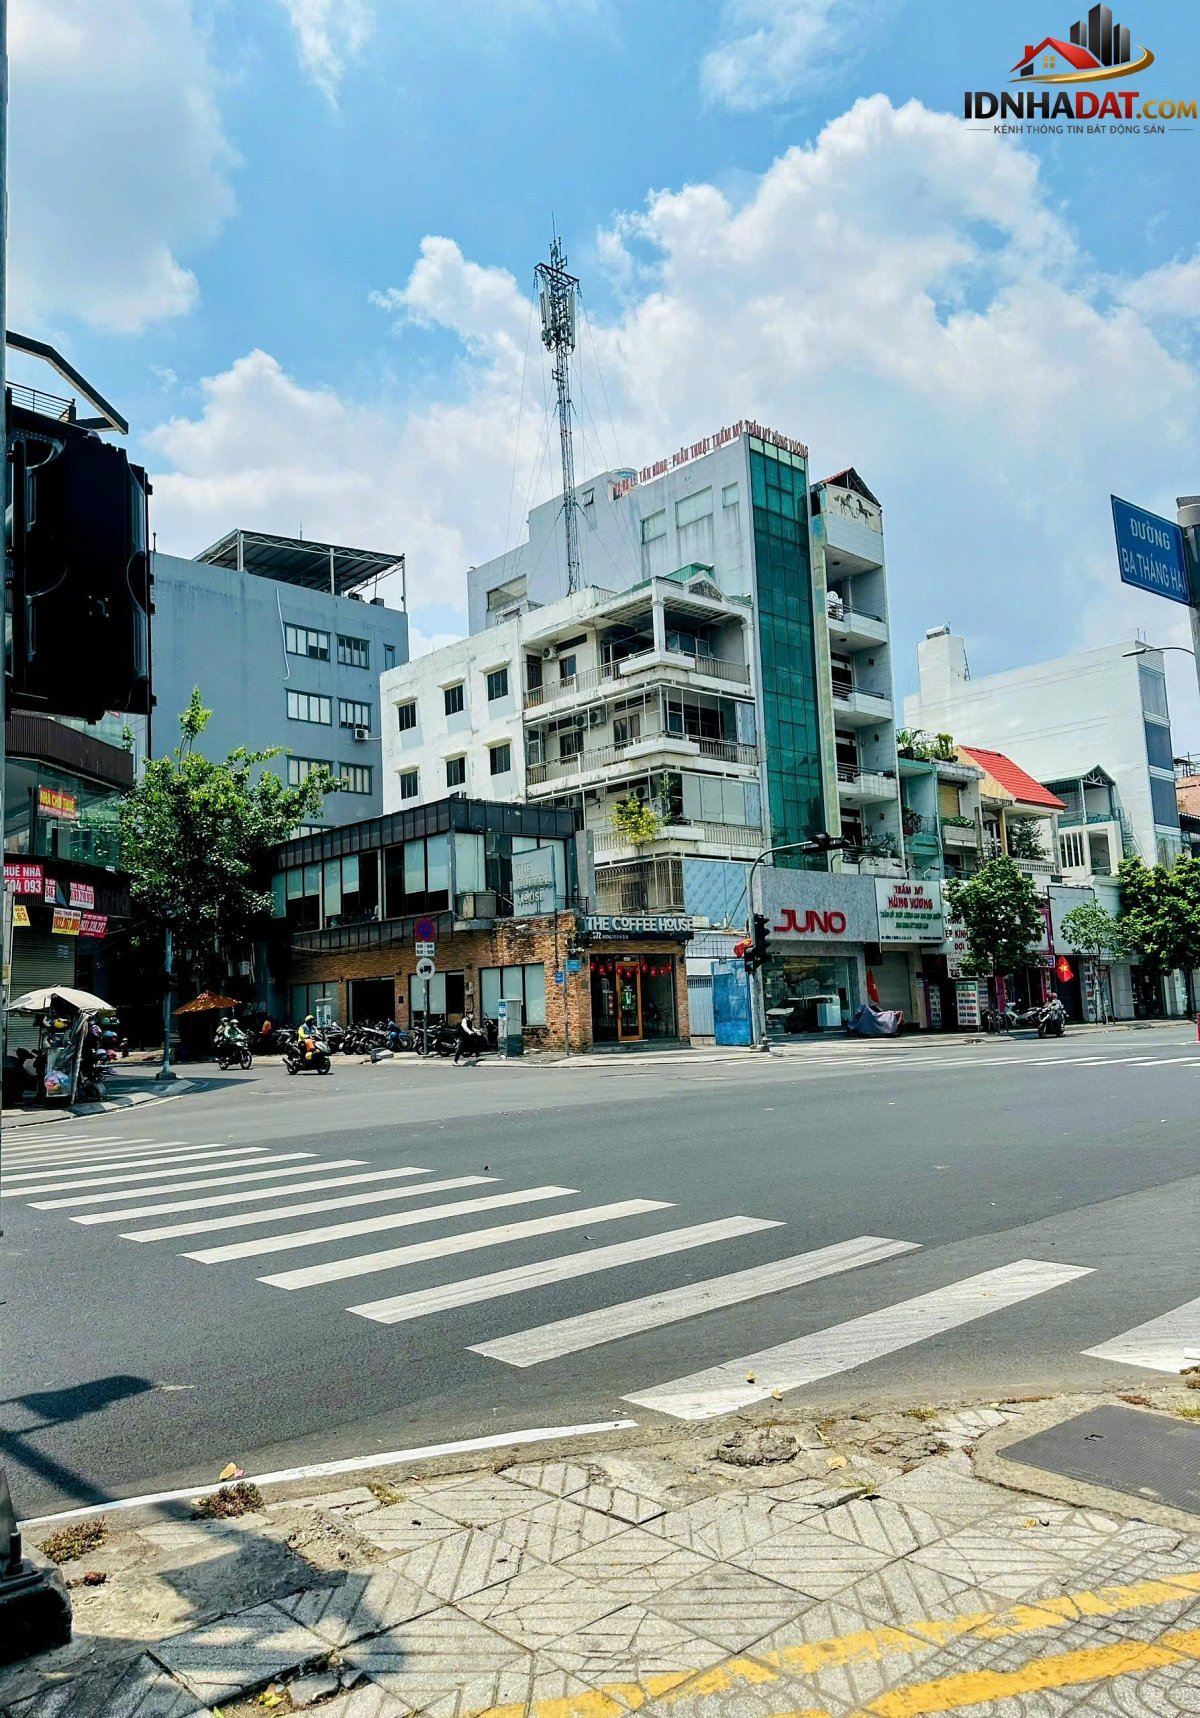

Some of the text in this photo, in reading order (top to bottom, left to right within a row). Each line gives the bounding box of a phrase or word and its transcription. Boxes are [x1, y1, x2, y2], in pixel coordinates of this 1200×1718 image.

[1130, 518, 1171, 551] ĐƯỜNG
[1122, 547, 1137, 576] BA
[1136, 552, 1169, 587] THÁNG
[4, 865, 41, 877] HUÊ NHÀ
[24, 880, 41, 893] 093
[586, 917, 695, 932] THE COFFEE HOUSE
[773, 909, 846, 934] JUNO
